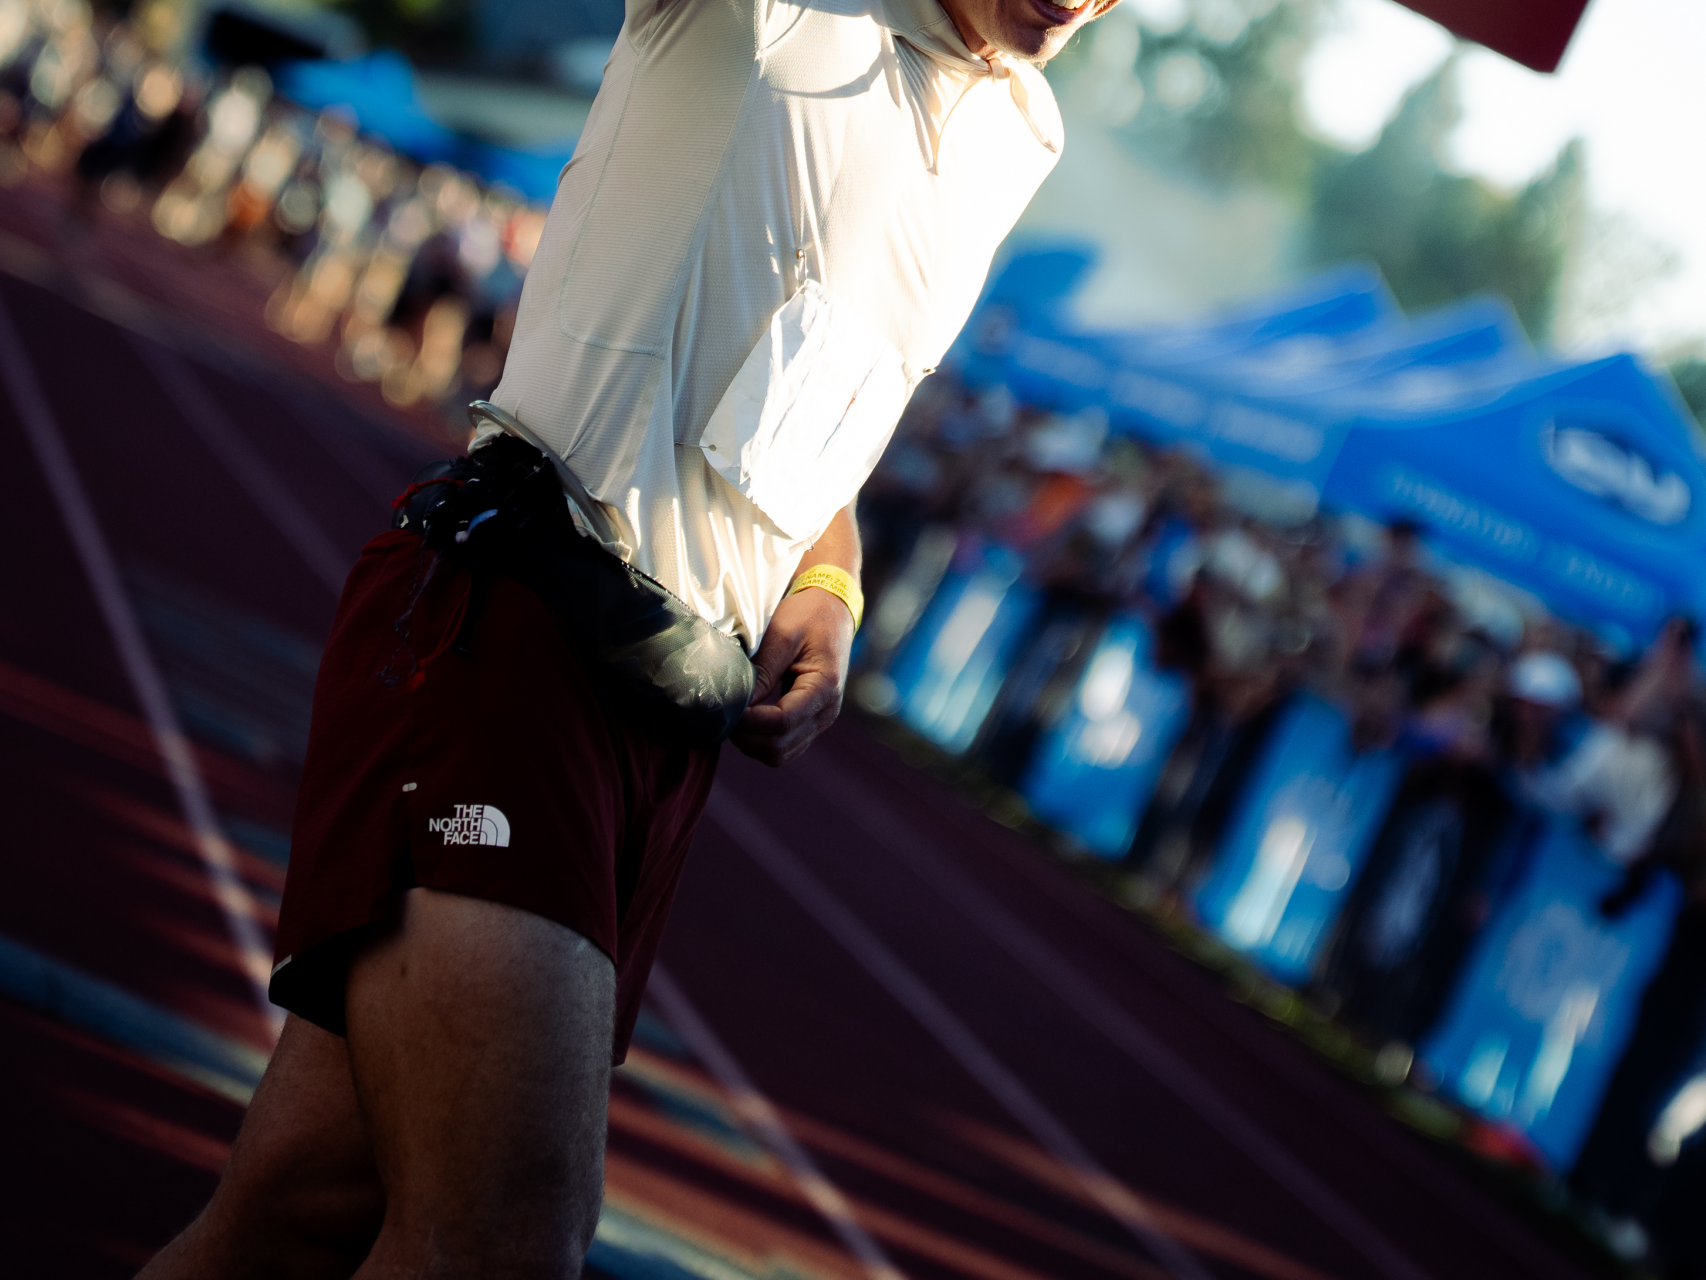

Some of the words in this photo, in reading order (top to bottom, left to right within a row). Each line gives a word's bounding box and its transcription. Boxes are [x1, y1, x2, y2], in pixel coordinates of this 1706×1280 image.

[454, 804, 483, 818] THE
[429, 818, 481, 832] NORTH
[443, 831, 479, 845] FACE
